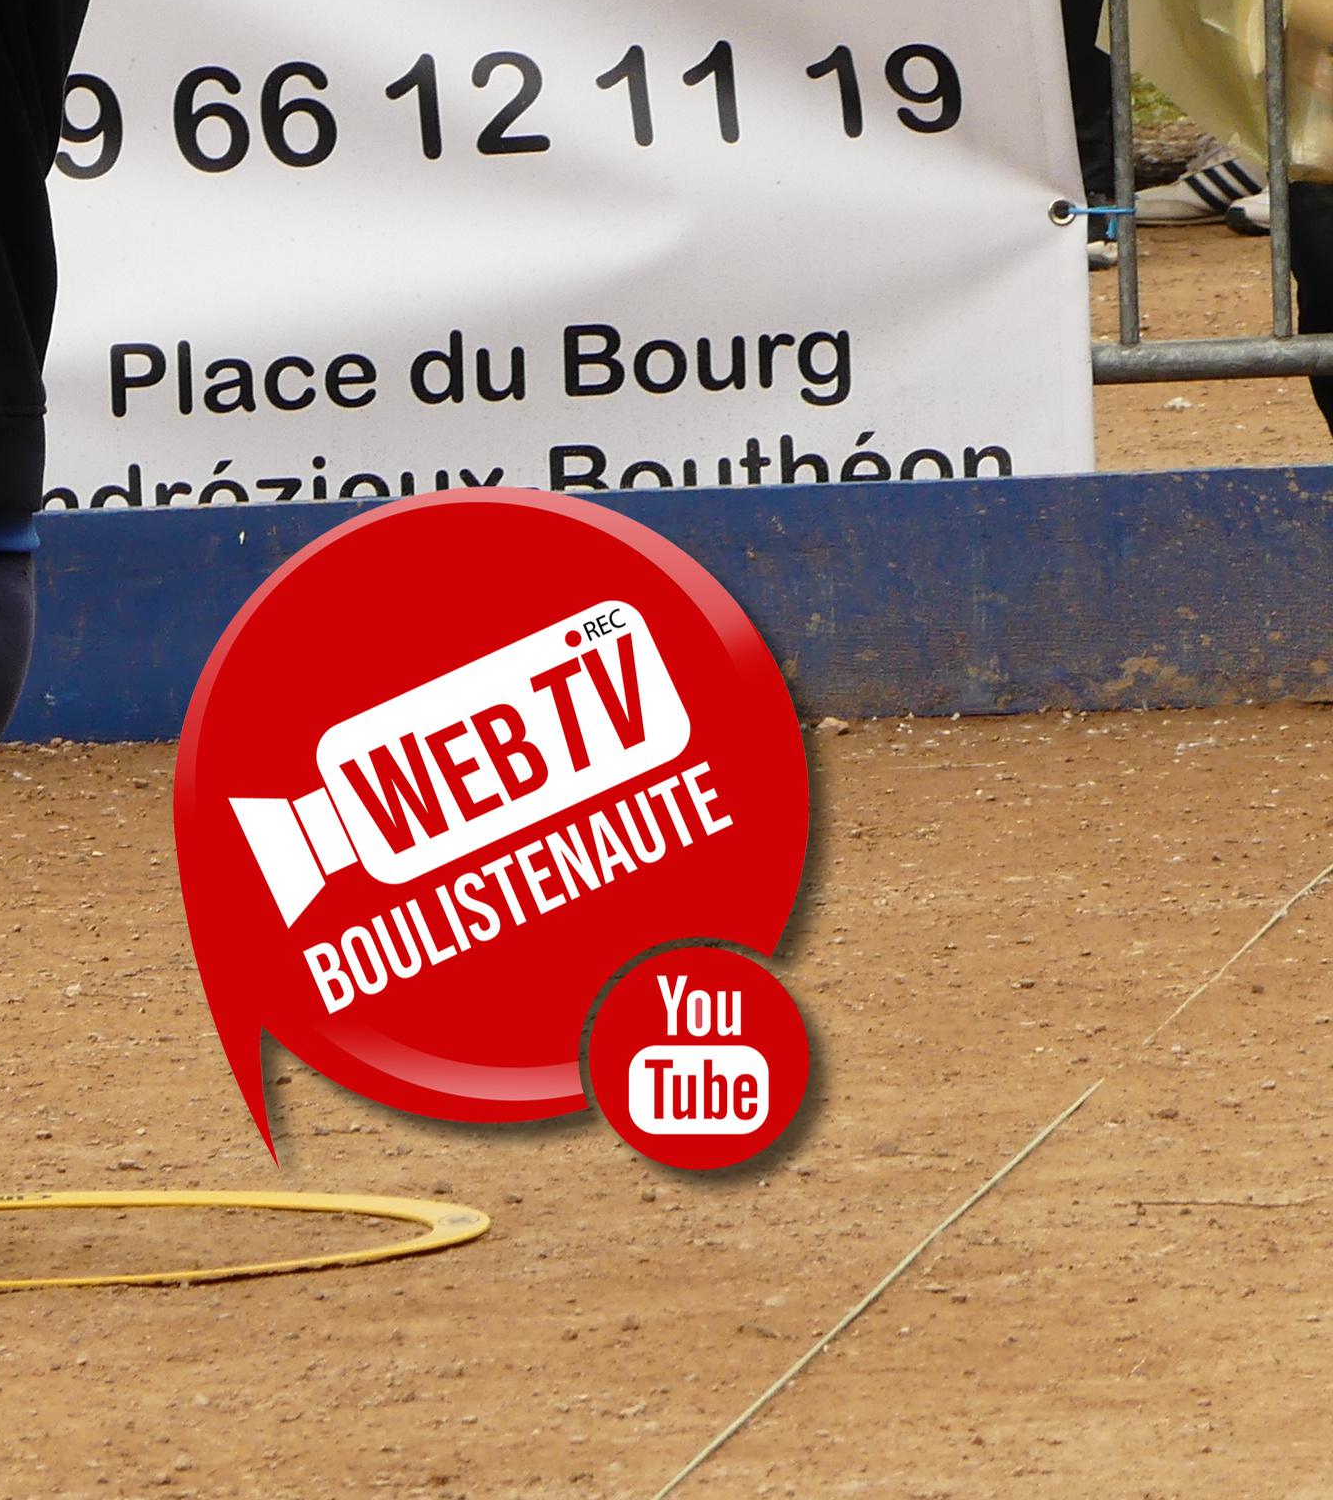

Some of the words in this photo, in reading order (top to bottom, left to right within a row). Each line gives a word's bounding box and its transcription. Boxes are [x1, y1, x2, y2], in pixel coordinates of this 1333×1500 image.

[172, 61, 339, 173] 66
[384, 51, 552, 161] 12
[595, 40, 741, 147] 11
[805, 43, 964, 140] 19
[108, 340, 378, 418] Place
[408, 329, 526, 405] du
[563, 323, 852, 407] Bourg
